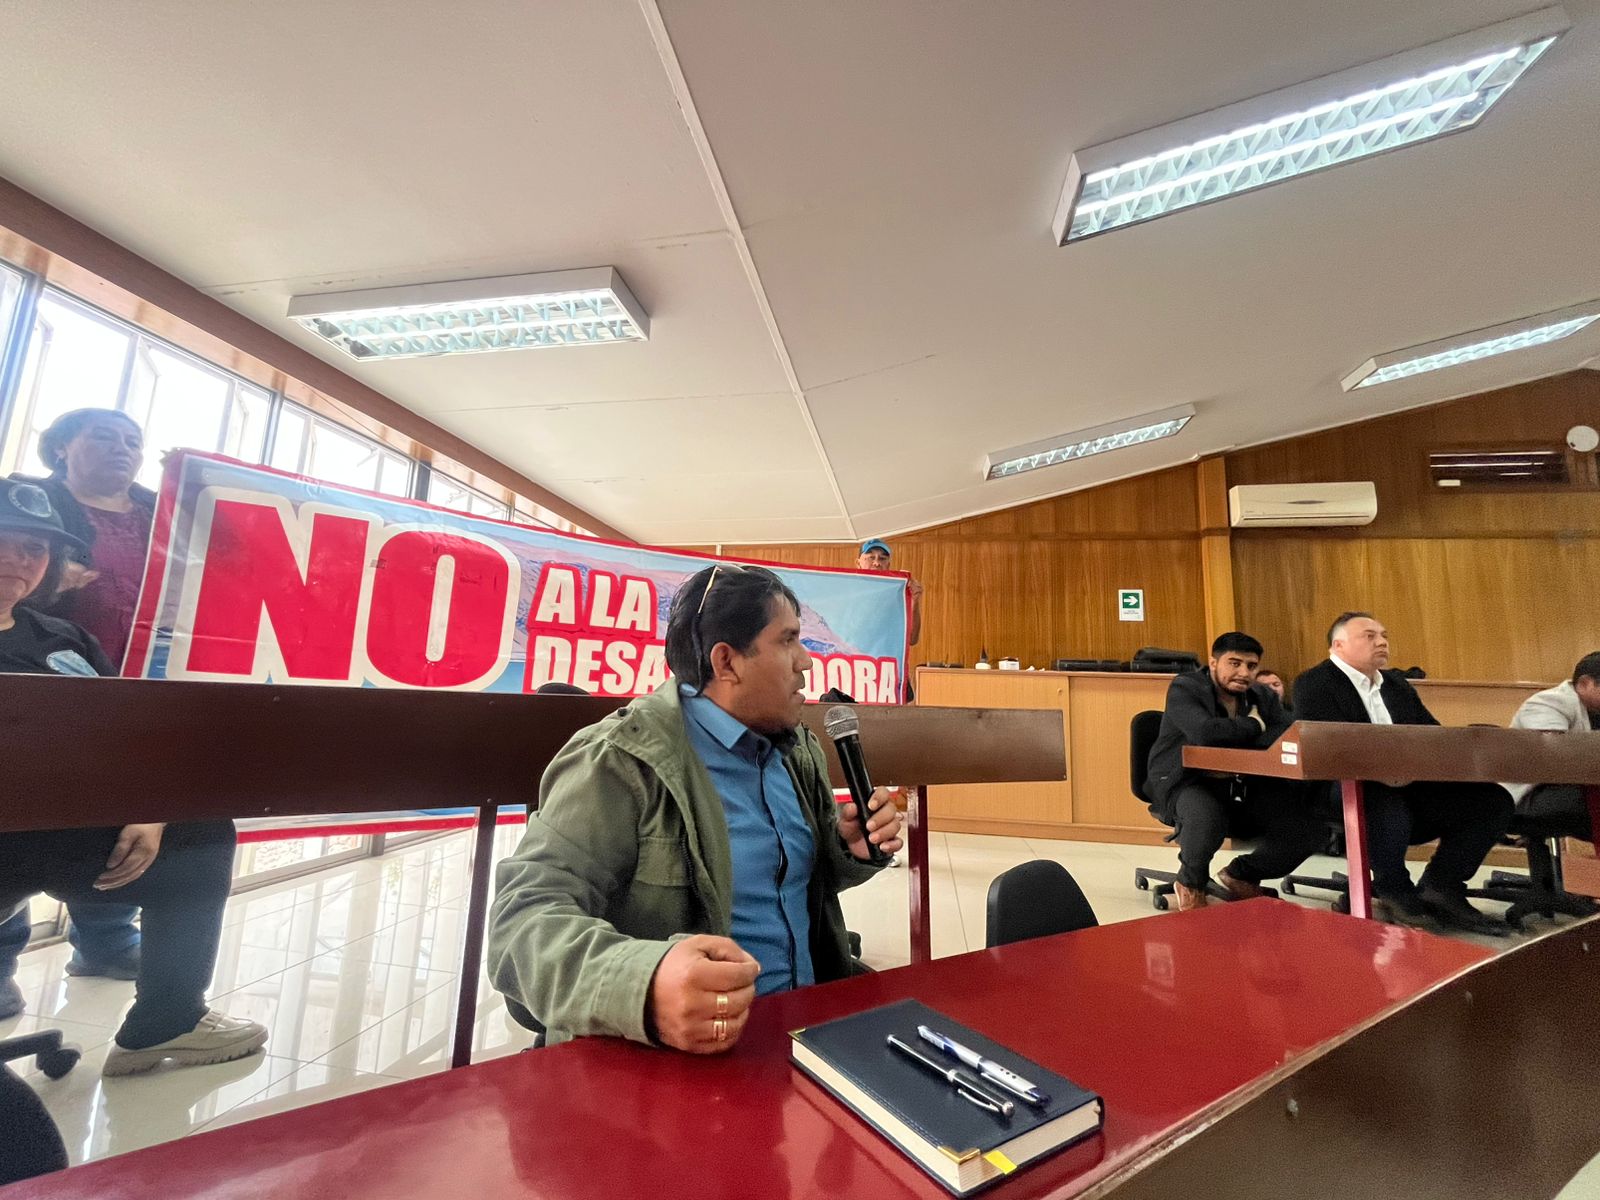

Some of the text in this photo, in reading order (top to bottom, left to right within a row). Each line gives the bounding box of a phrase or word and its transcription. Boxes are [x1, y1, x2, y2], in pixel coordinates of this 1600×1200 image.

[185, 498, 510, 688] NO
[535, 567, 651, 632] A LA
[531, 635, 897, 704] DESADORA
